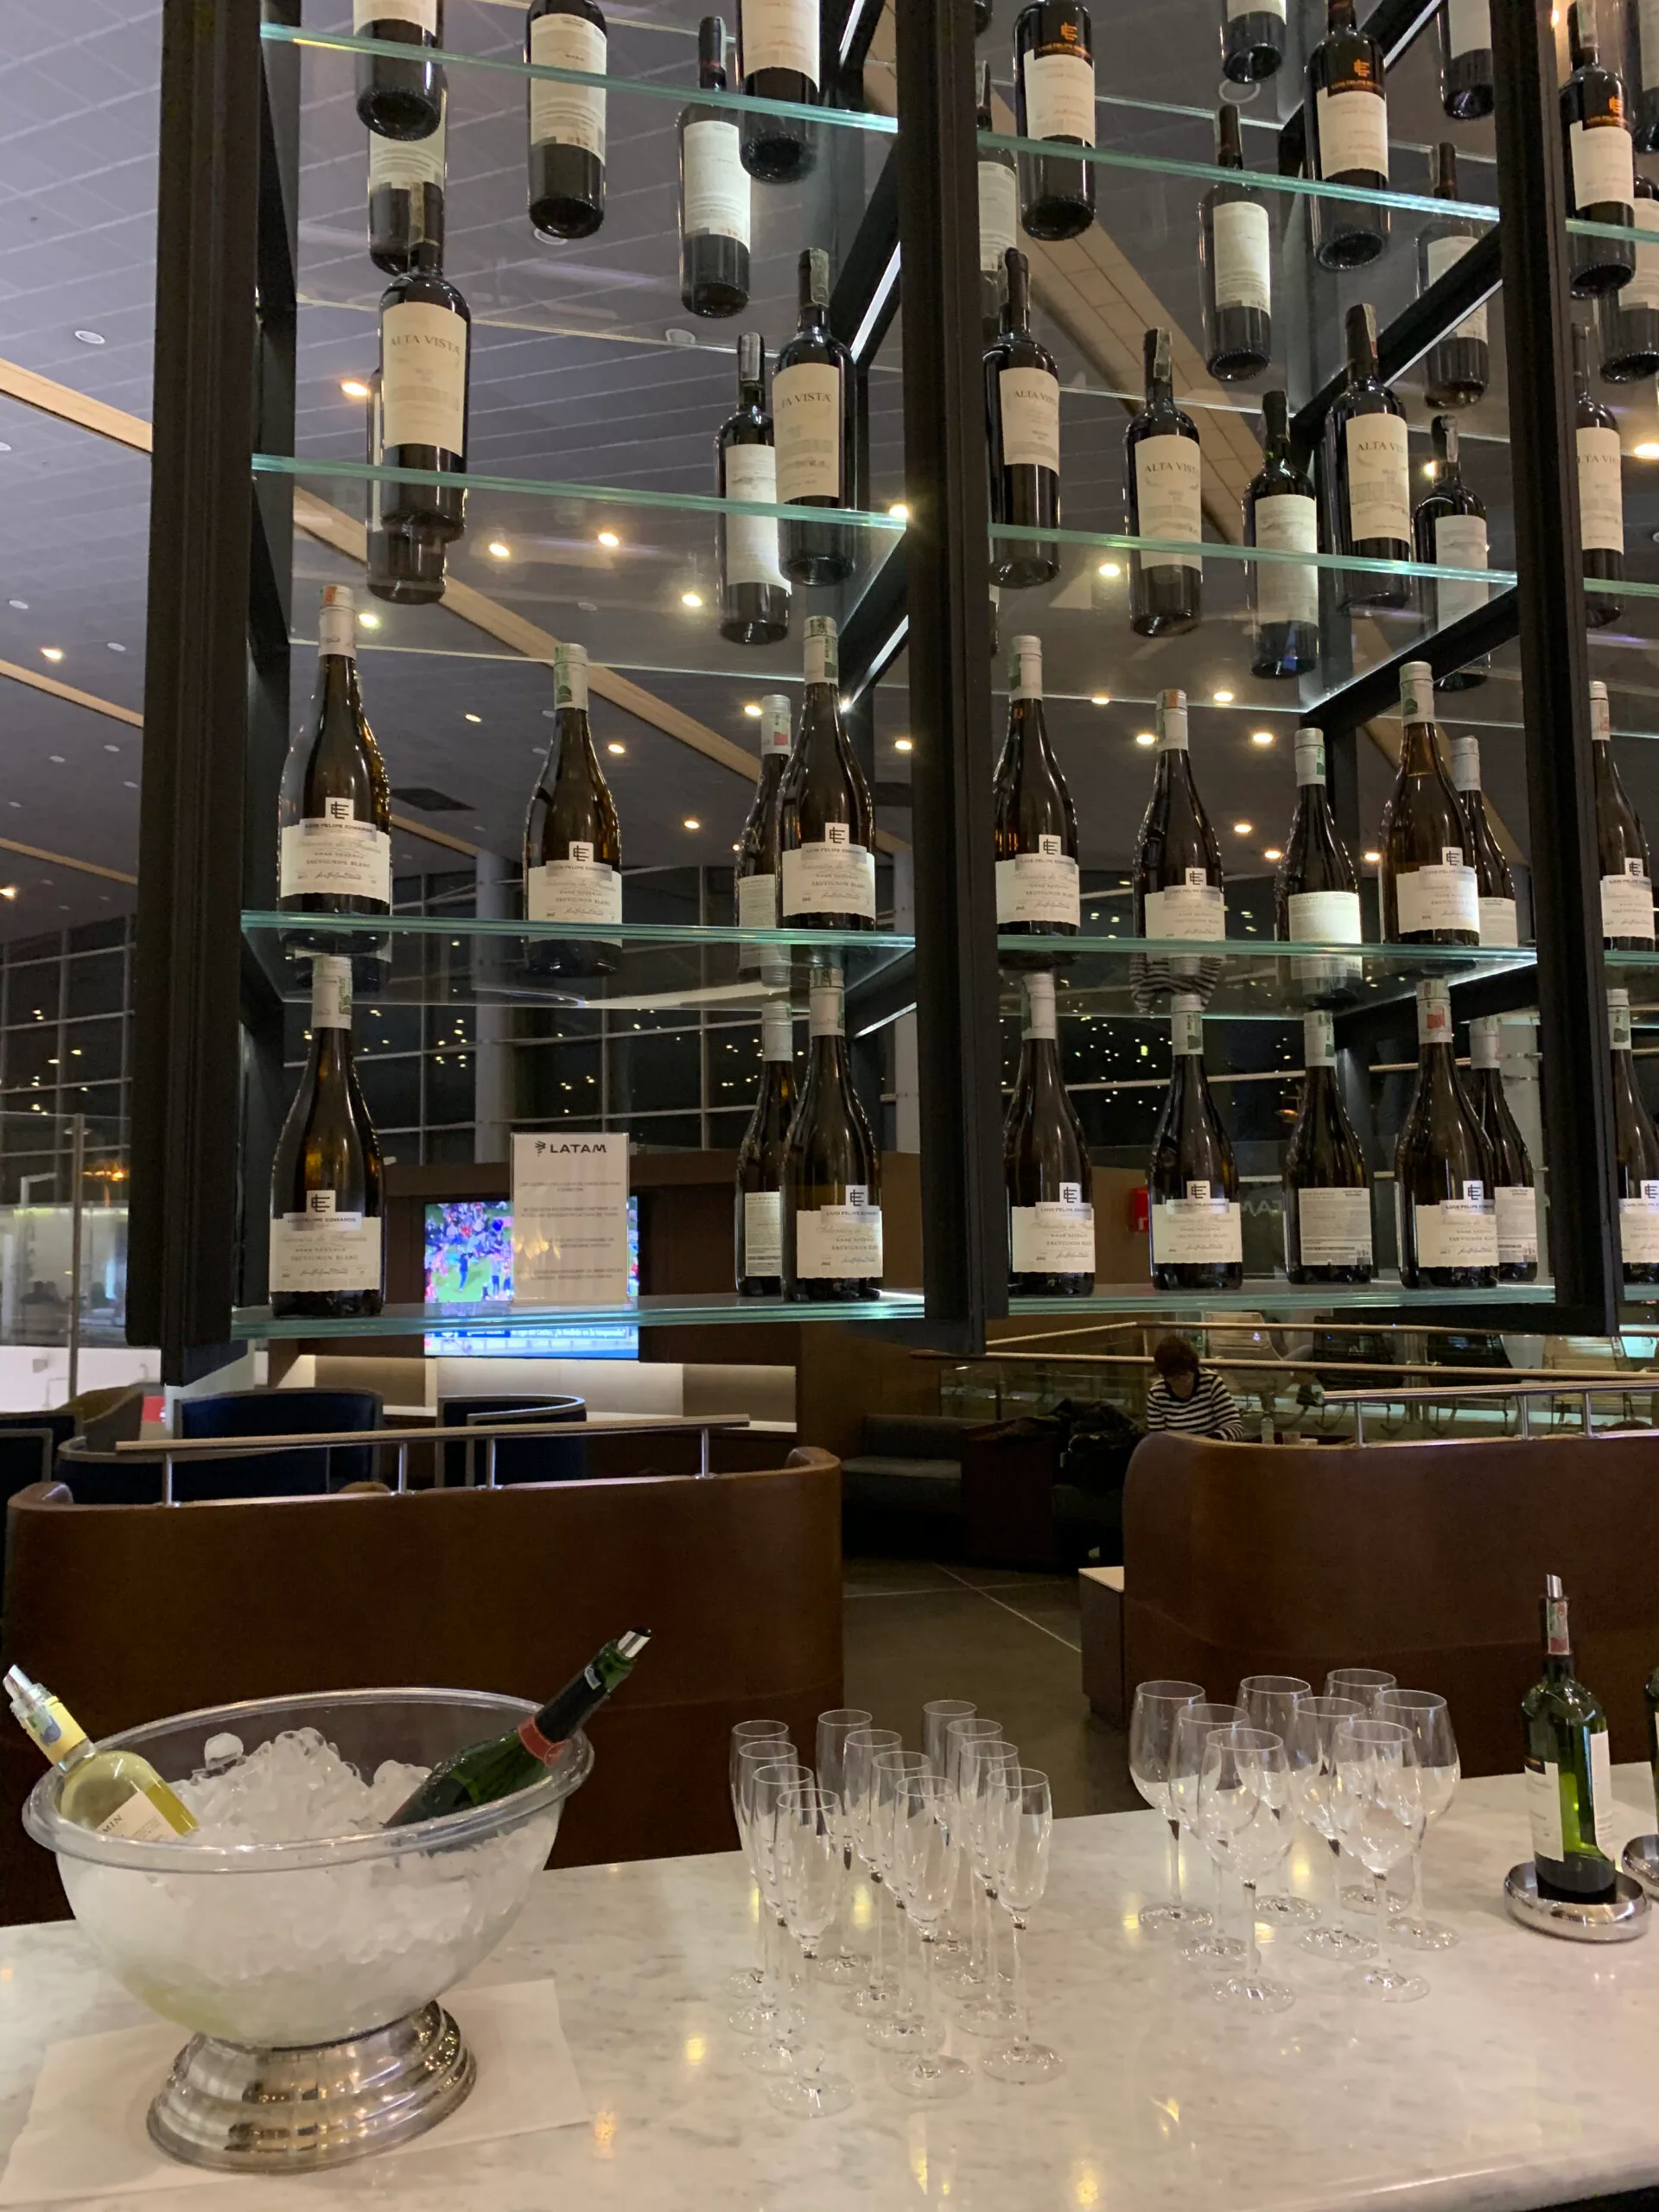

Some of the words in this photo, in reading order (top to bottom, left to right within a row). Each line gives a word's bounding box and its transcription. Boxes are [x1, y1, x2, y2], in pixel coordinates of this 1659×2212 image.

[424, 335, 461, 357] VISTA
[794, 392, 833, 404] VISTA
[1357, 442, 1388, 451] ALTA
[1145, 461, 1173, 474] ALTA
[550, 1143, 607, 1154] LATAM
